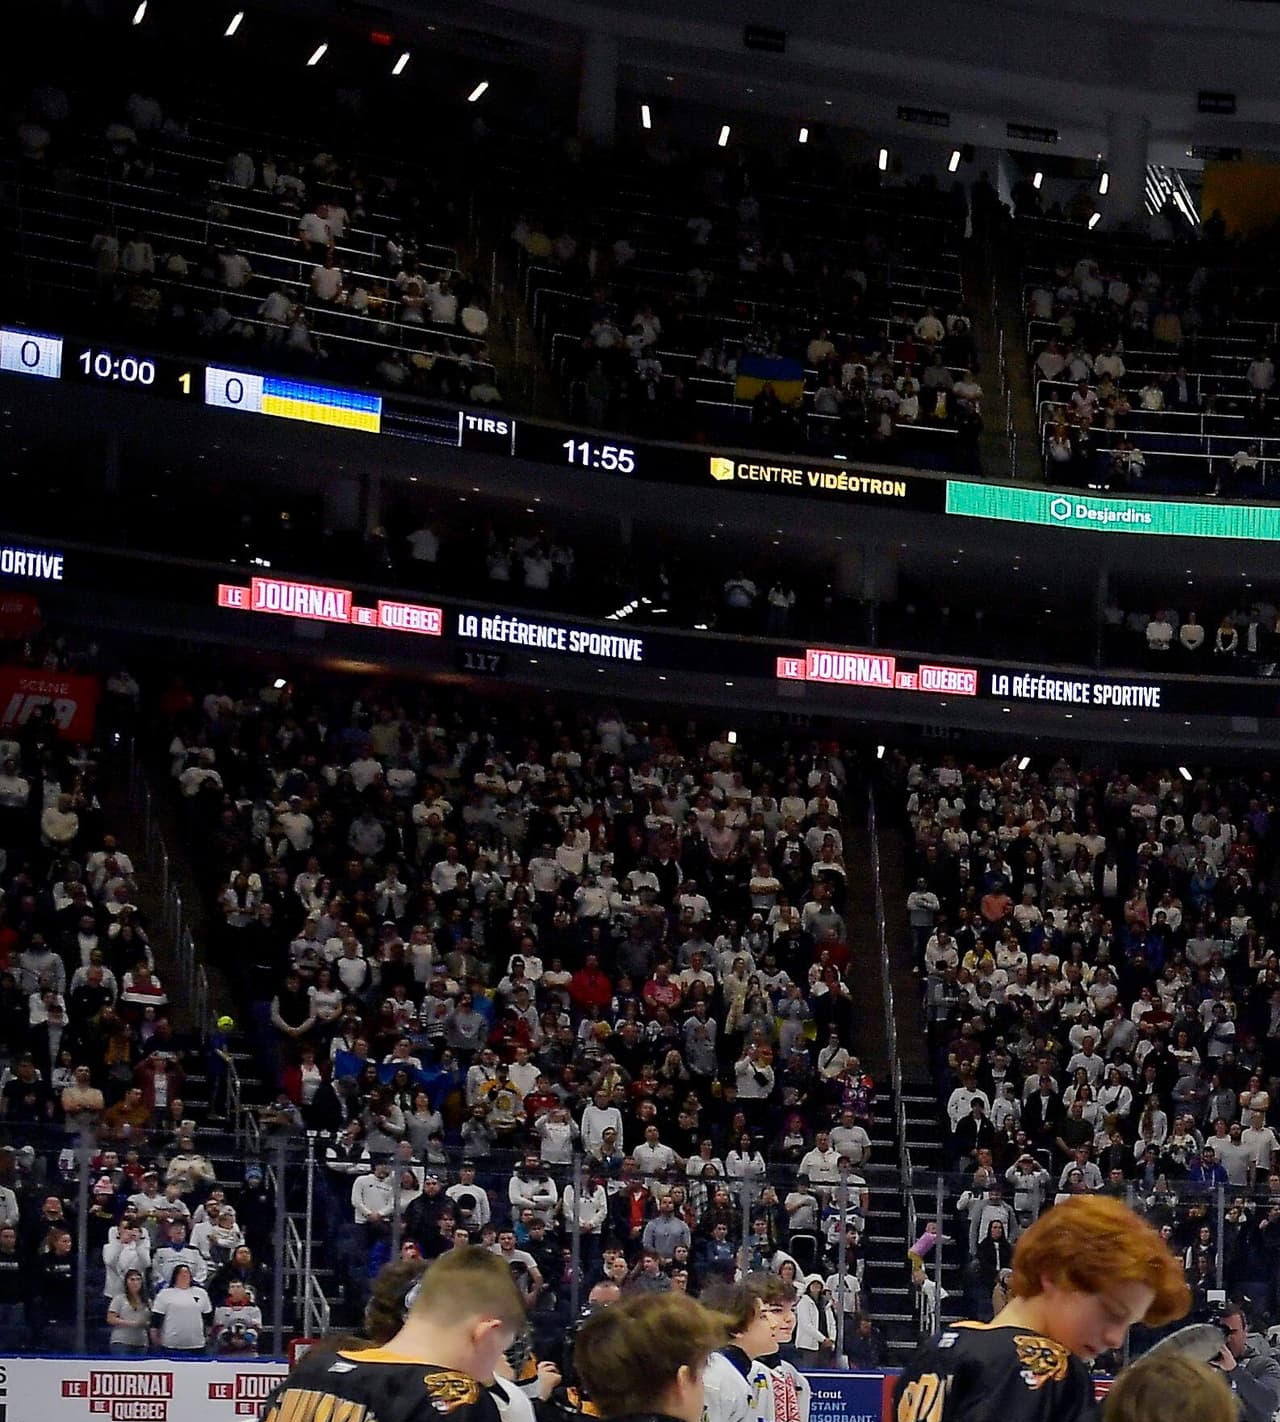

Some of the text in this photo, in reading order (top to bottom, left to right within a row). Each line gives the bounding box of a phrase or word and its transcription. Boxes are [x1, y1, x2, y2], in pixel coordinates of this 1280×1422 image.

[20, 340, 243, 403] 0 10:00 1 0
[466, 415, 508, 435] TIRS
[562, 440, 635, 473] 11:55
[738, 464, 906, 497] CENTRE VIDÉOTRON
[1074, 505, 1152, 526] Desjardins
[228, 582, 438, 632] LE JOURNAL DE QUÉBEC
[458, 614, 643, 661] LA RÉFÉRENCE SPORTIVE
[463, 653, 499, 672] 117
[785, 654, 974, 692] LE JOURNAL DE QUÉBEC
[992, 674, 1160, 708] LA RÉFÉRENCE SPORTIVE
[68, 1382, 81, 1396] LE
[92, 1373, 171, 1397] JOURNAL
[215, 1384, 227, 1398] LE
[94, 1401, 105, 1412] DE
[115, 1401, 165, 1420] QUÉBEC
